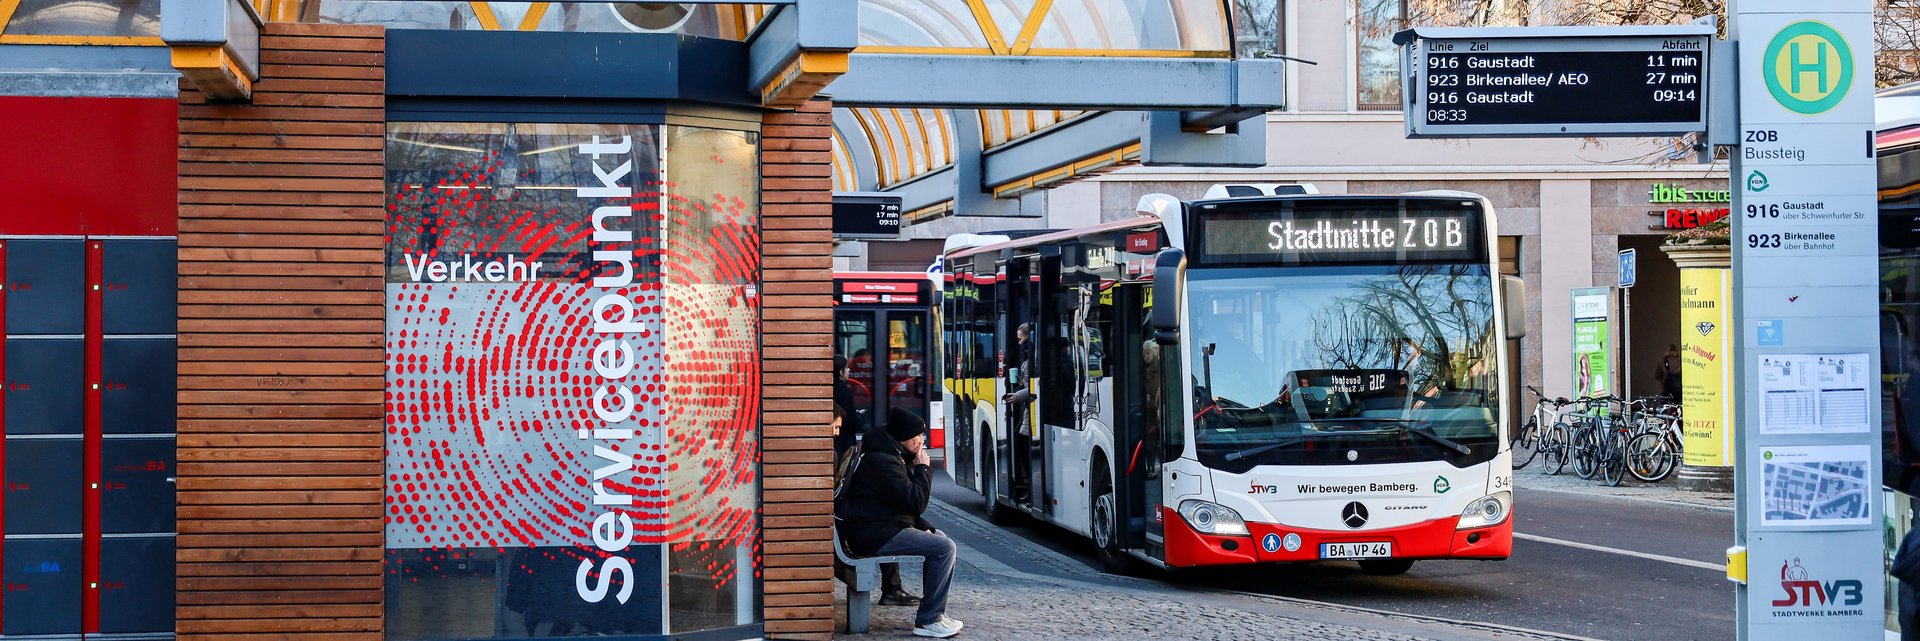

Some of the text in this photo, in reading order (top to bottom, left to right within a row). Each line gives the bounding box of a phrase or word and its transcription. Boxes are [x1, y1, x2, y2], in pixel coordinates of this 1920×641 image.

[1429, 39, 1701, 51] Linie Ziel Abfahrt
[1429, 55, 1697, 70] 916 Gaustadt 11 min
[1790, 42, 1828, 94] H
[1428, 72, 1697, 87] 923 Birkenallee/ AEO 27 min
[1428, 90, 1696, 104] 916 Gaustadt 09:14
[1428, 109, 1467, 122] 08:33
[1745, 130, 1778, 143] ZOB
[1745, 147, 1805, 161] Bussteig
[1653, 182, 1688, 203] ibis
[1747, 203, 1780, 219] 916
[1783, 202, 1824, 210] Gaustadt
[1783, 211, 1866, 220] über Schweinfurter Str.
[1267, 219, 1395, 250] Stadtmitte
[1402, 219, 1416, 248] Z
[1445, 217, 1462, 247] B
[1784, 232, 1836, 241] Birkenallee
[1748, 233, 1781, 249] 923
[1803, 242, 1835, 250] Bahnhof
[404, 253, 543, 283] Verkehr
[1691, 345, 1716, 361] Altgold
[576, 134, 646, 606] Servicepunkt
[1693, 420, 1716, 429] JETZT
[1688, 429, 1712, 439] Gewinn!
[1297, 482, 1419, 495] Wir bewegen Bamberg.
[1330, 543, 1387, 557] BA VP 46
[1772, 609, 1864, 618] STADTWERKE BAMBERG
